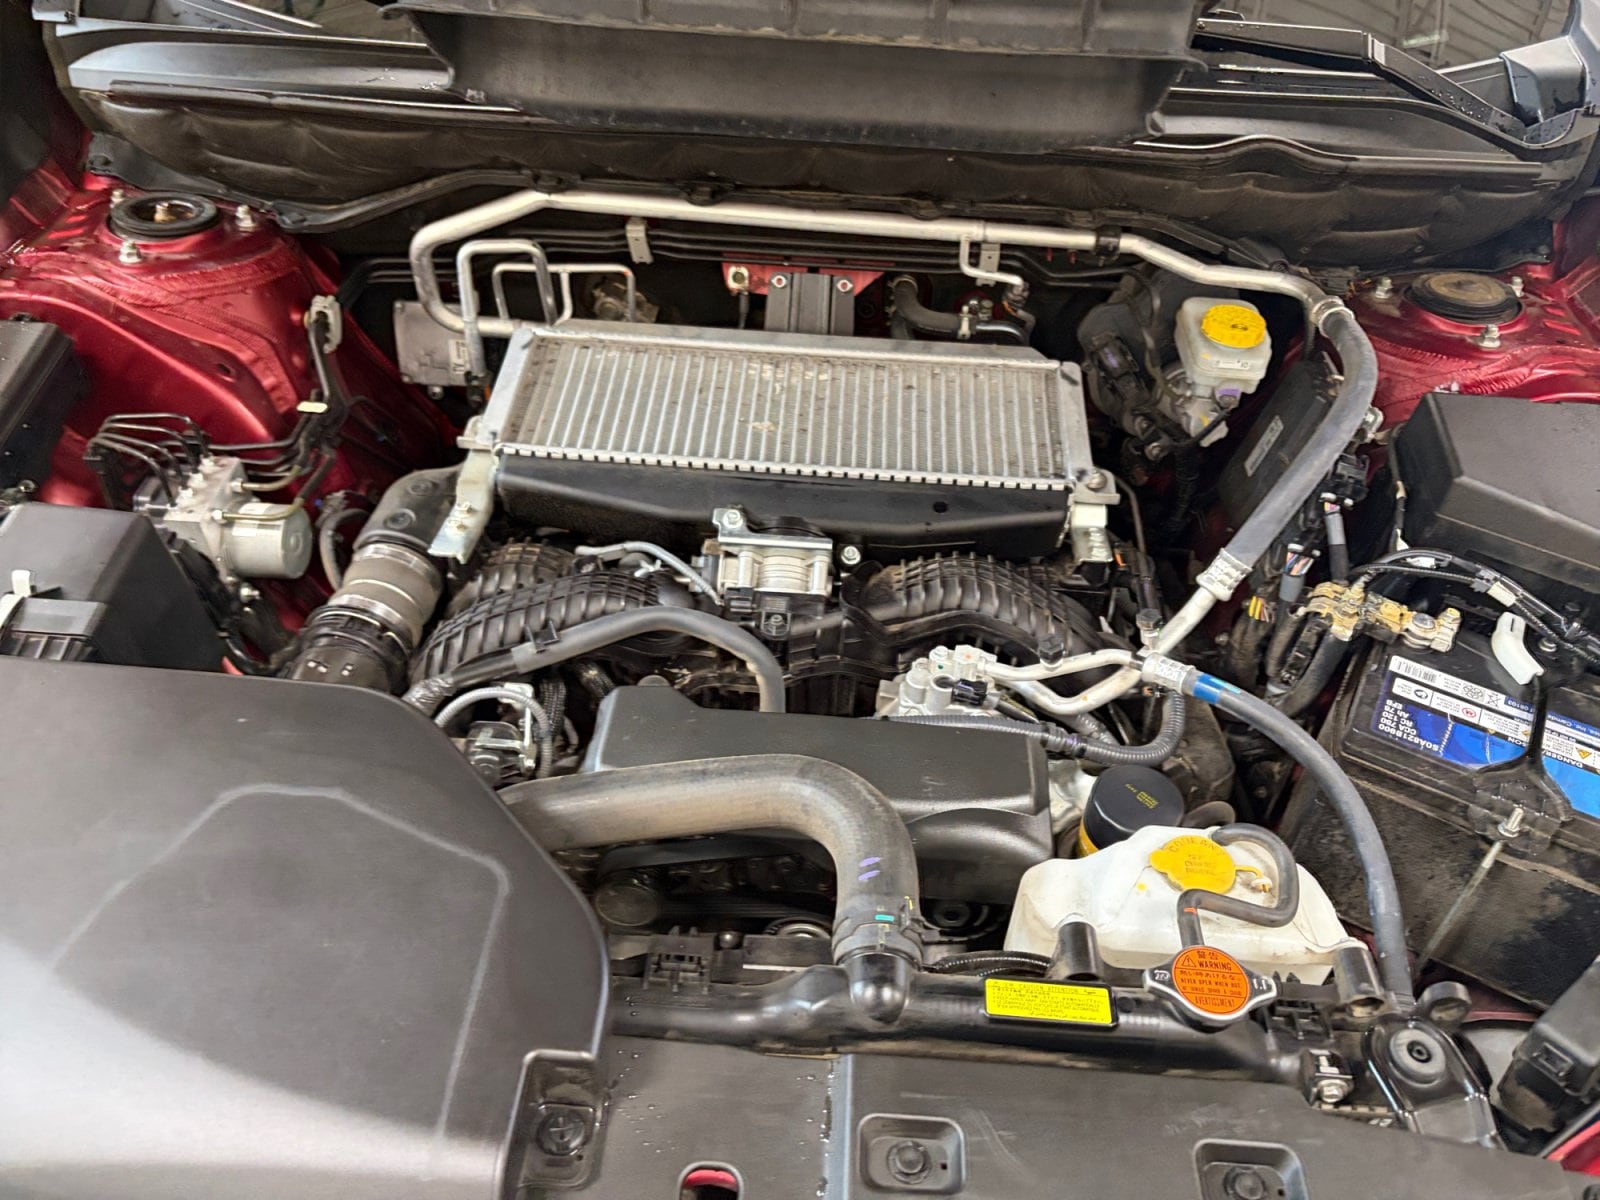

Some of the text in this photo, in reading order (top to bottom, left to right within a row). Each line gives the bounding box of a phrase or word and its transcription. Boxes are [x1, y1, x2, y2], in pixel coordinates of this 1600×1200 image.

[1382, 711, 1414, 728] RC 120
[1398, 723, 1417, 736] CCA
[1198, 960, 1232, 972] WARNING
